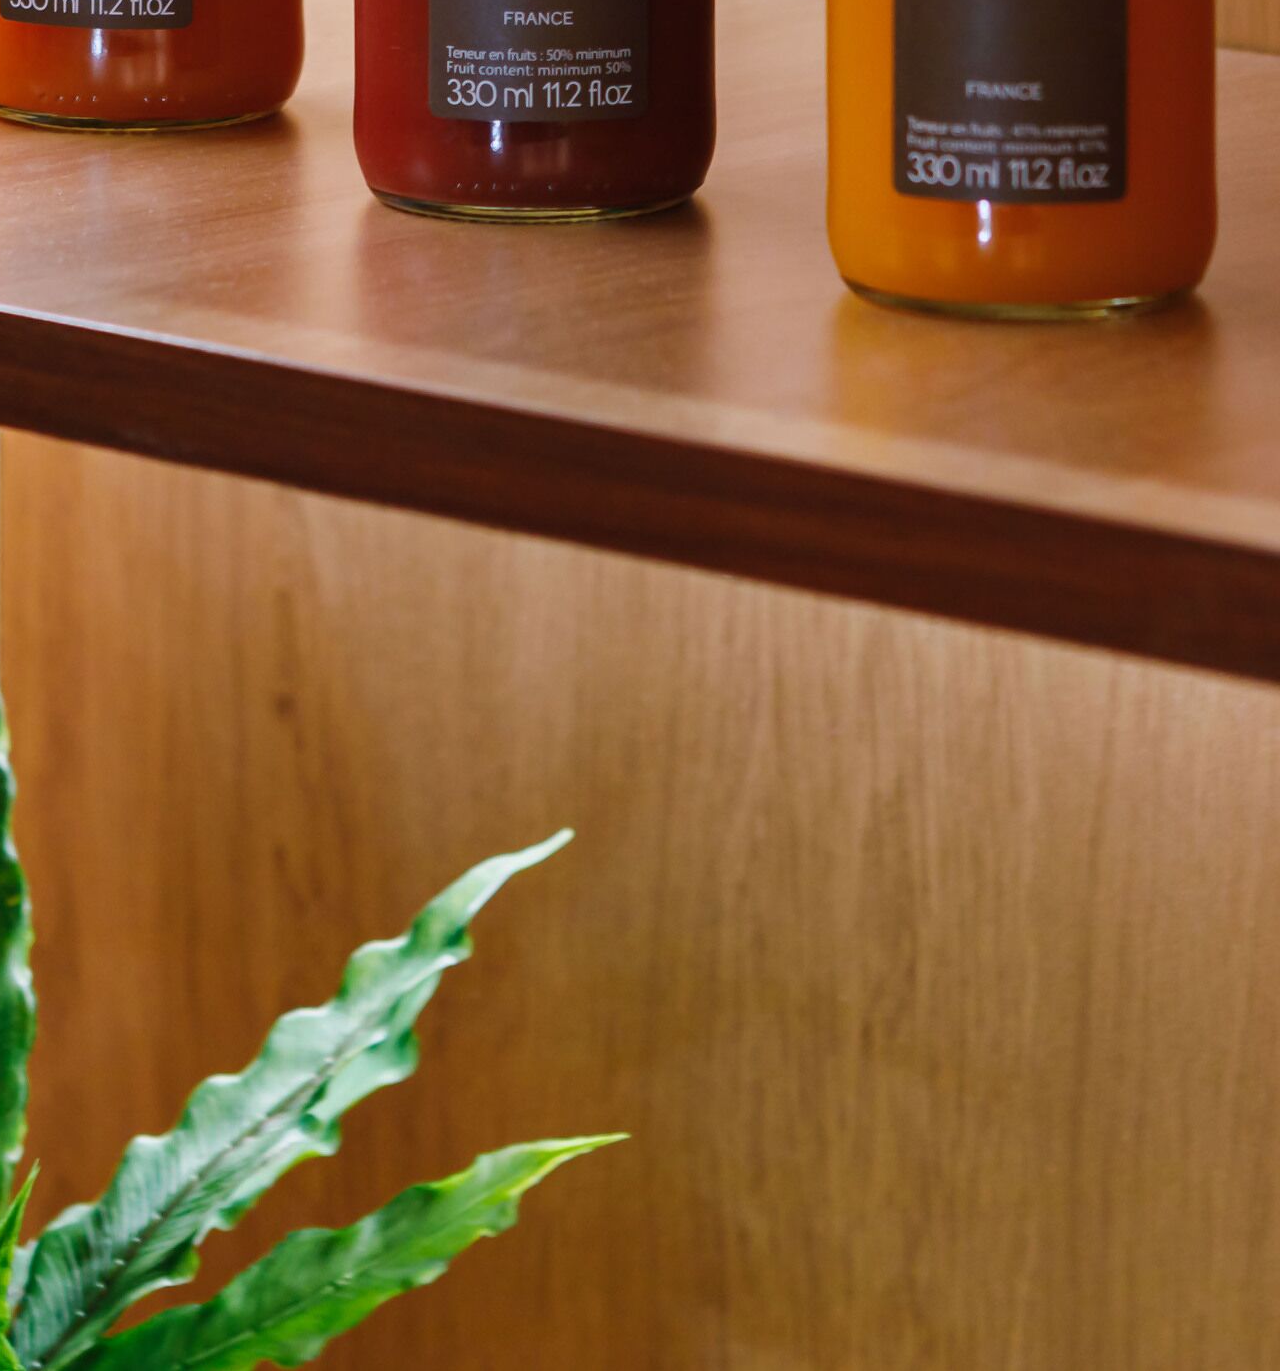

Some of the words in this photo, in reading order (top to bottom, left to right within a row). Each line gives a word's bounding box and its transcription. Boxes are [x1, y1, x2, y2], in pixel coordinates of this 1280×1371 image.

[503, 11, 574, 26] FRANCE
[446, 45, 486, 61] Teneur
[489, 50, 504, 61] en
[507, 48, 537, 61] fruits
[546, 49, 573, 62] 50%
[576, 47, 631, 61] minimum
[446, 61, 475, 75] Fruit
[537, 64, 602, 76] minimum
[605, 61, 631, 74] 50%
[447, 79, 497, 108] 330
[503, 82, 533, 108] ml
[542, 81, 582, 108] 11.2
[588, 80, 632, 108] fl.oz
[965, 81, 1043, 100] FRANCE
[906, 151, 961, 186] 330
[965, 159, 1000, 189] ml
